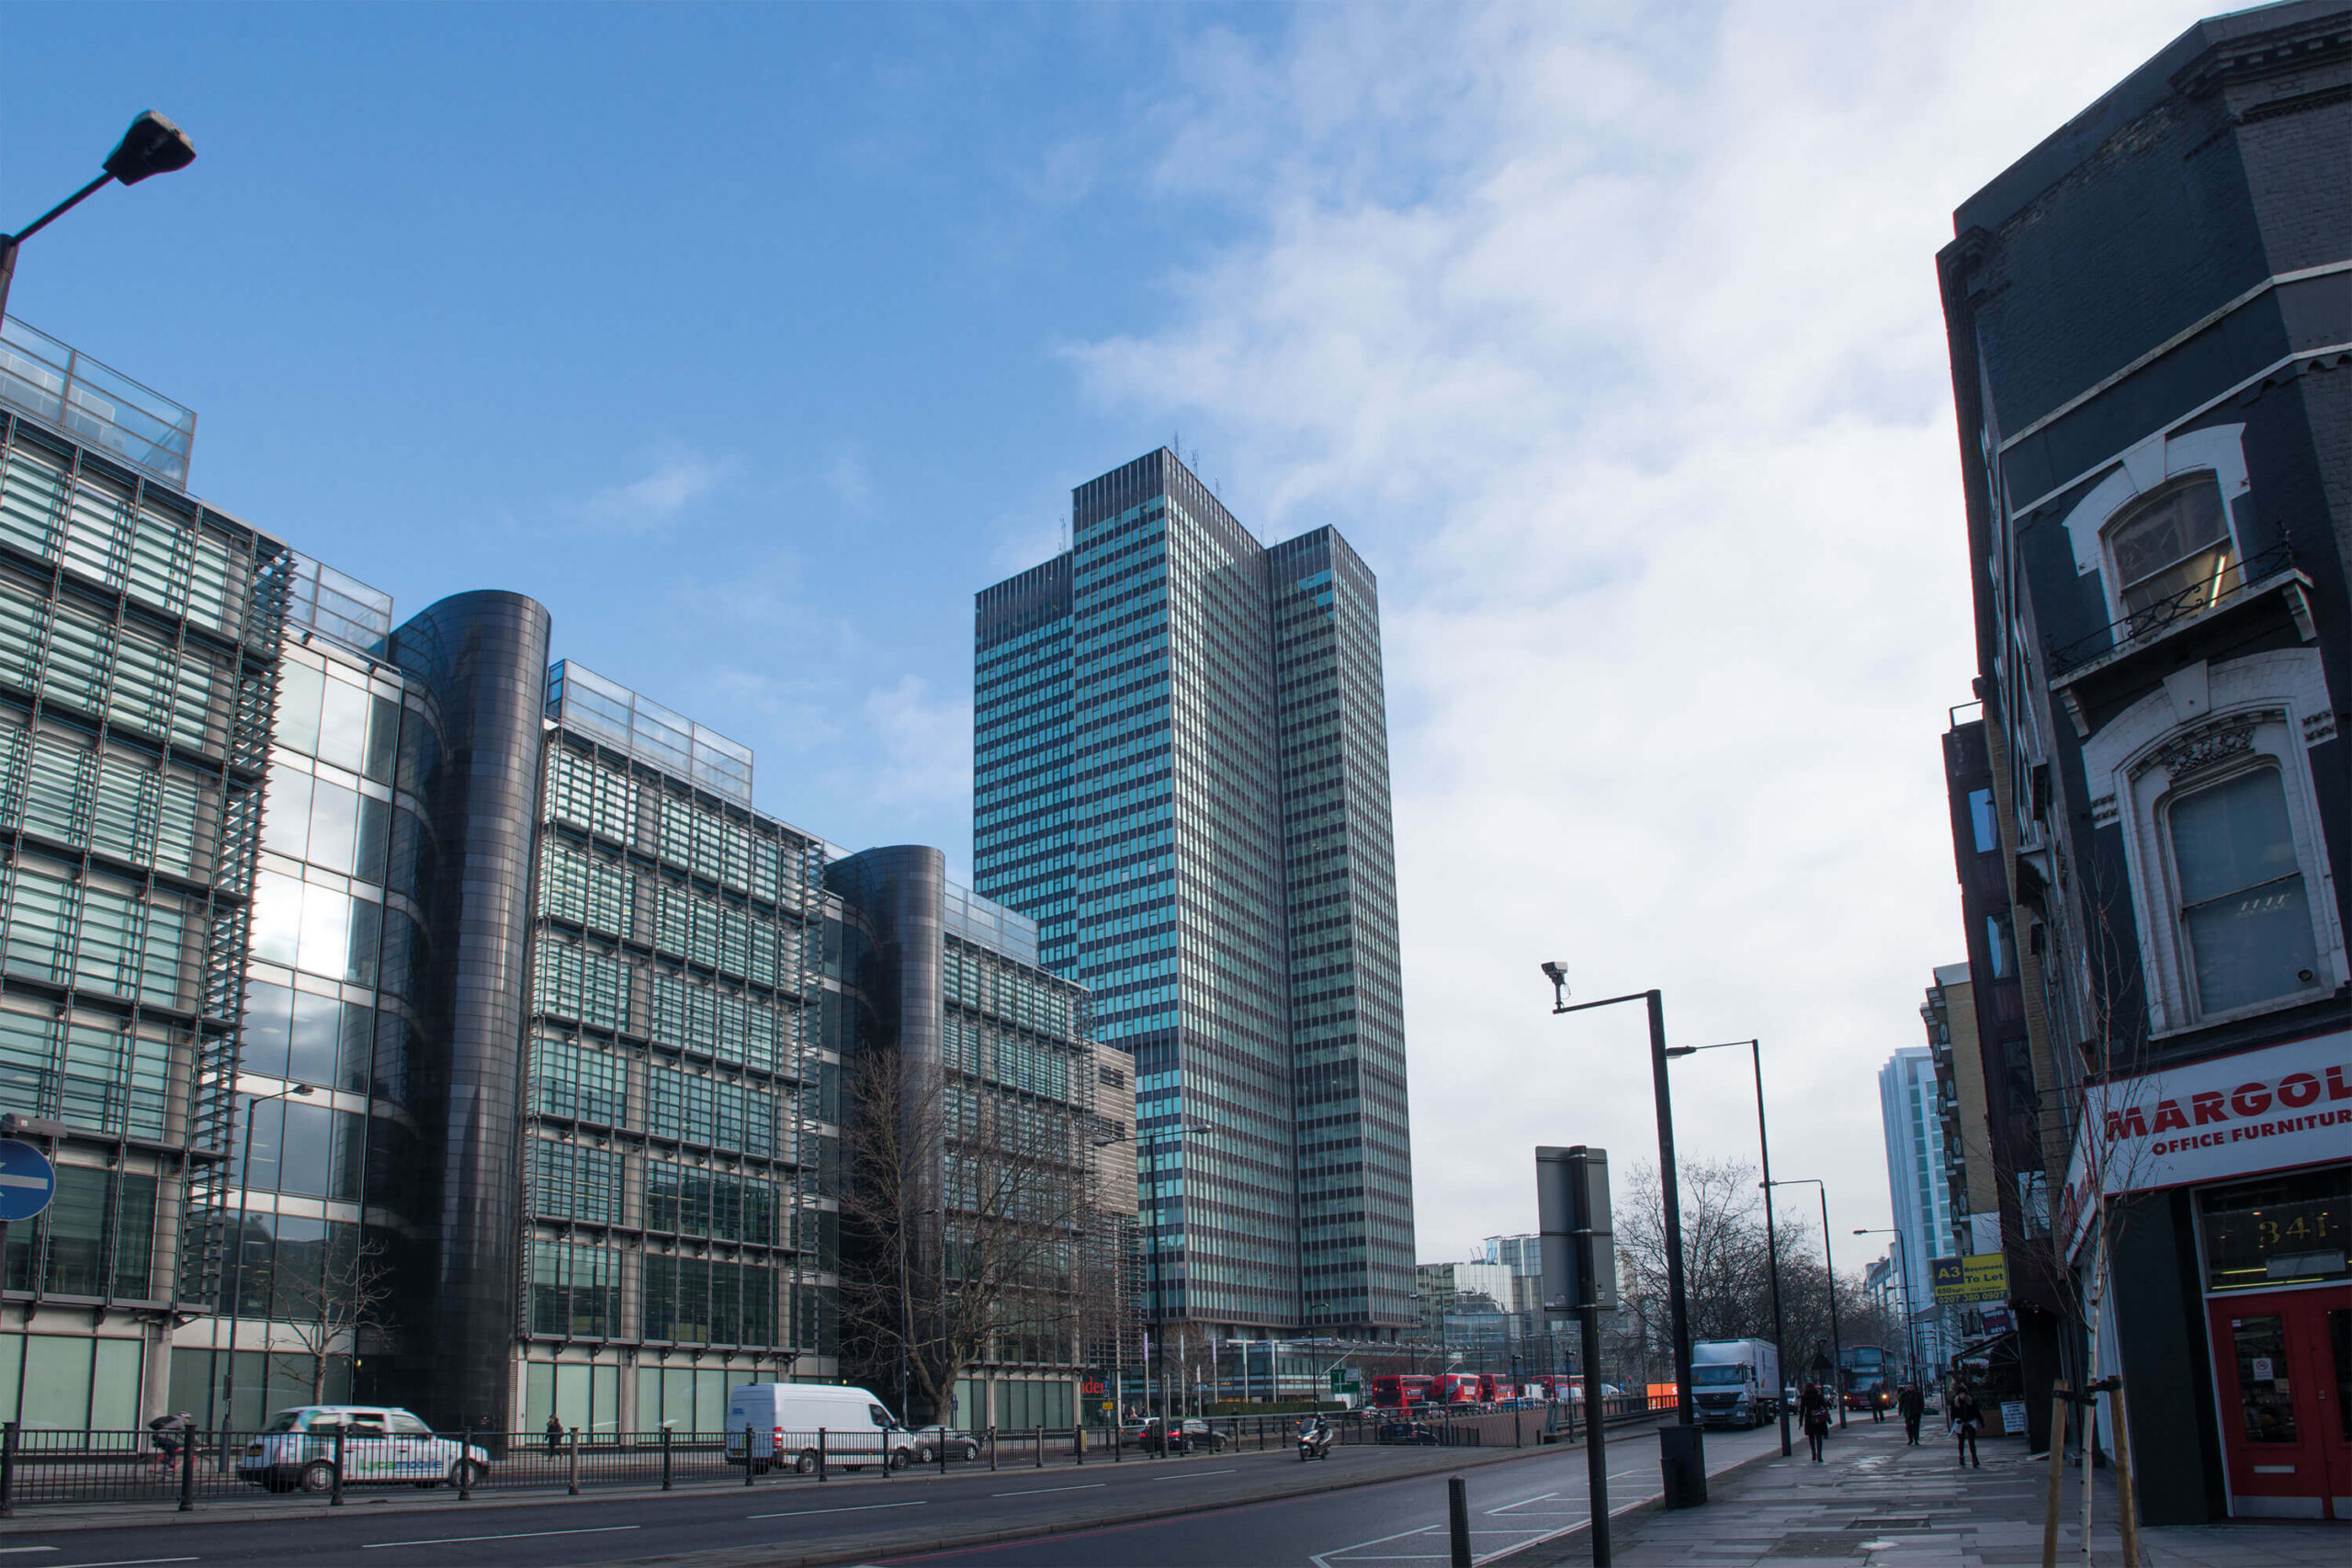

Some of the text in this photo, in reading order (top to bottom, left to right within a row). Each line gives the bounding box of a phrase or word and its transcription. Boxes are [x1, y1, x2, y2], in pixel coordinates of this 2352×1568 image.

[2152, 1132, 2224, 1156] OFFICE
[1938, 1266, 1961, 1280] A3
[1965, 1273, 2005, 1284] To Let
